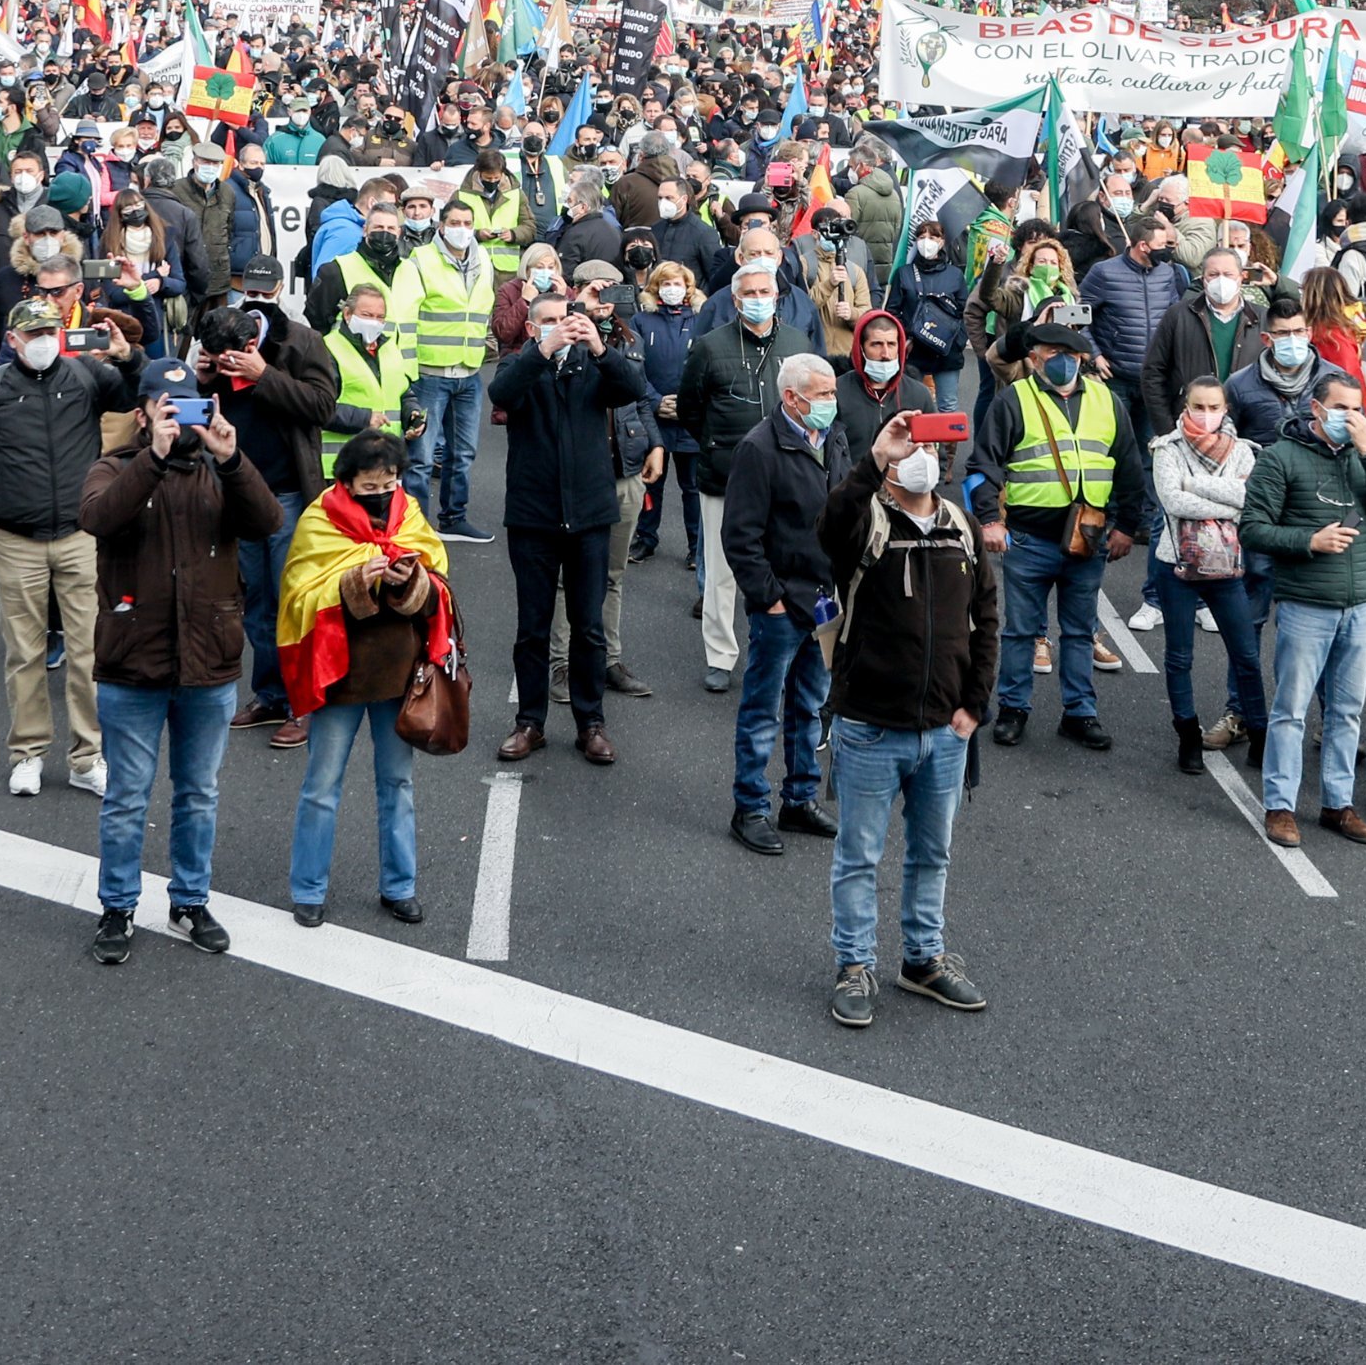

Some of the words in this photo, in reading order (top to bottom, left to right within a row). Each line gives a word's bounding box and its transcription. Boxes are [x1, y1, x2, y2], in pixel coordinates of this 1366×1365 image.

[249, 4, 315, 15] COMBATIENTE
[624, 35, 636, 45] UN
[978, 12, 1093, 39] BEAS
[1108, 14, 1163, 43] DE
[1178, 16, 1361, 48] SEGURA
[974, 42, 1033, 60] CON
[1043, 42, 1075, 59] EL
[1082, 41, 1176, 67] OLIVAR
[621, 61, 630, 71] DE
[1121, 71, 1212, 93] cultura
[1212, 80, 1236, 100] y
[919, 327, 947, 349] IBEROJET
